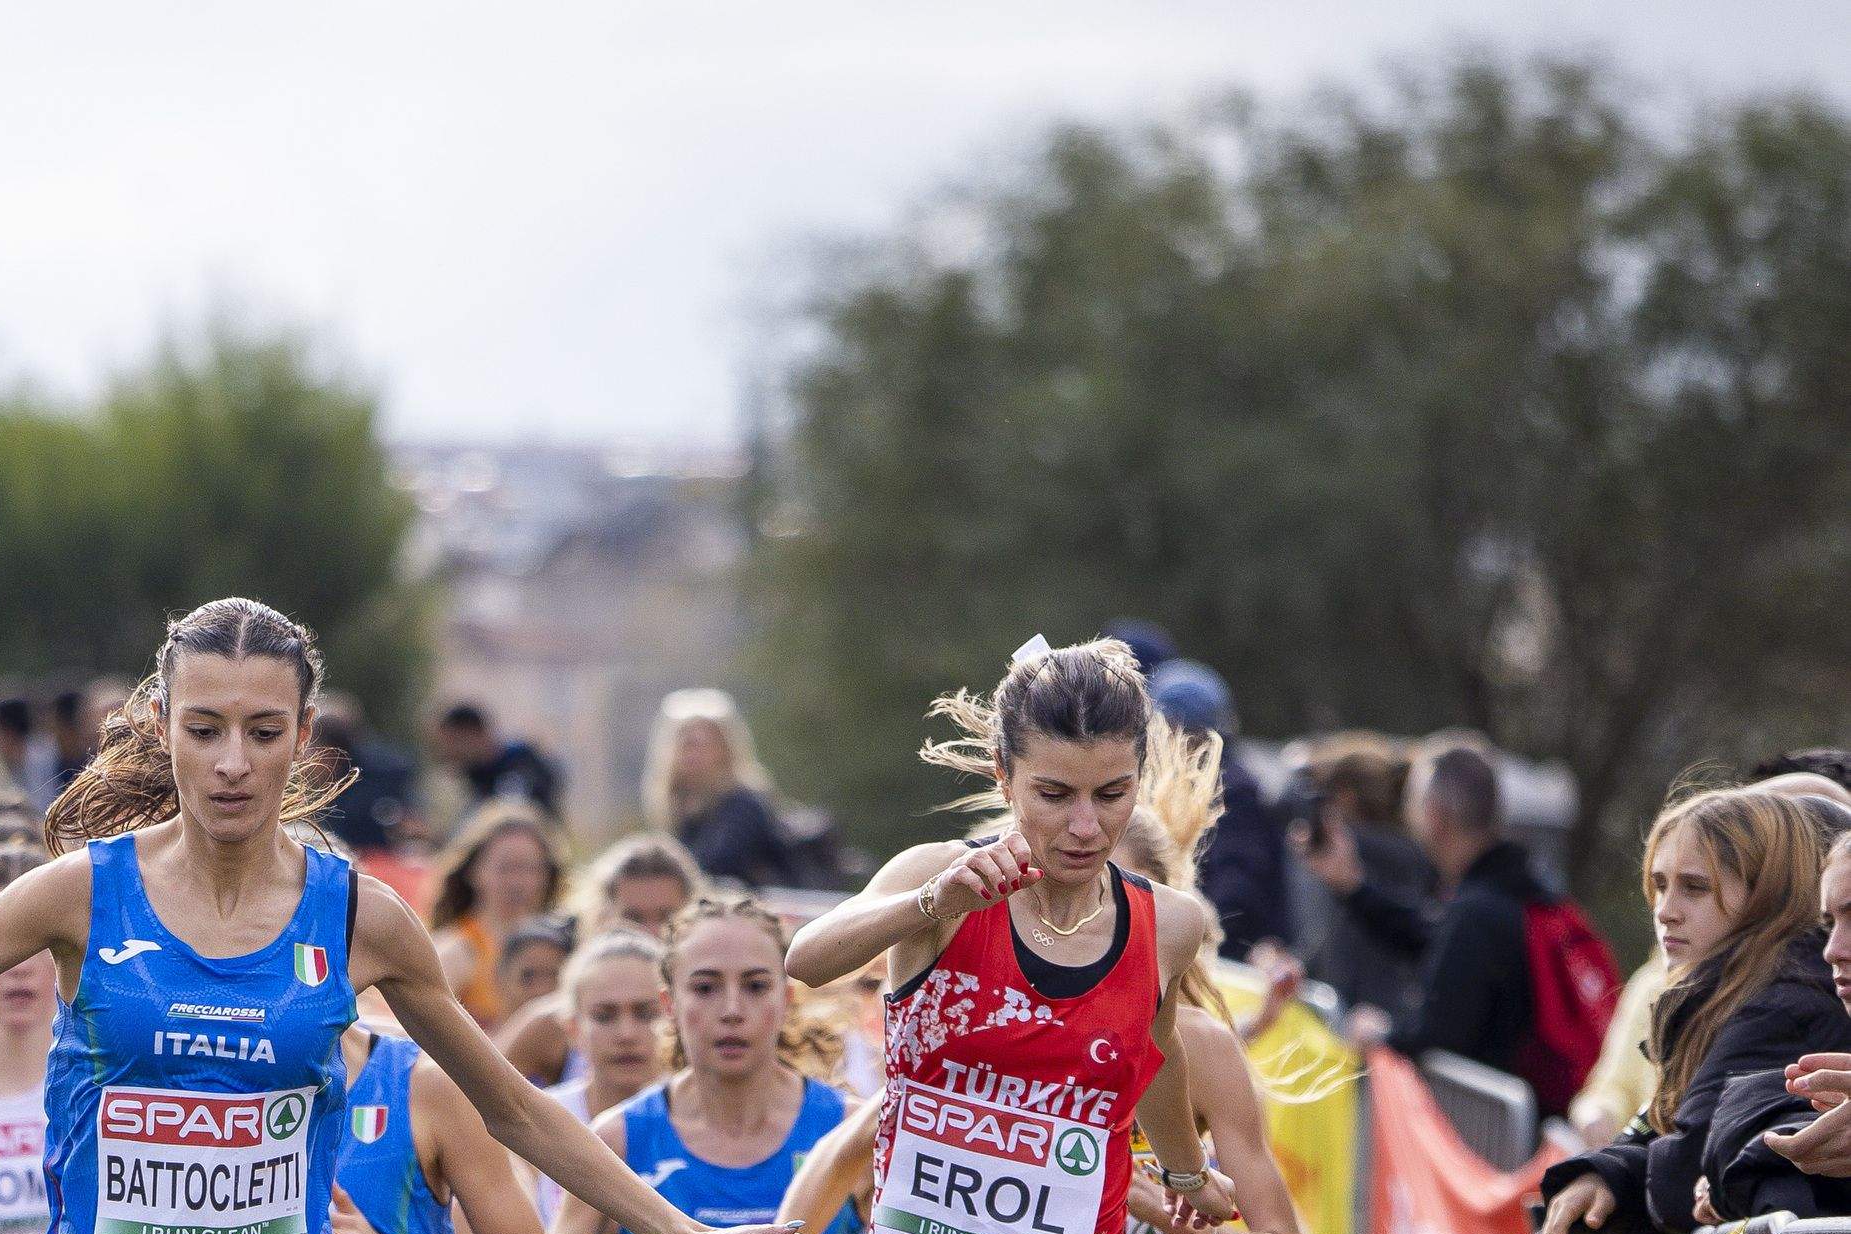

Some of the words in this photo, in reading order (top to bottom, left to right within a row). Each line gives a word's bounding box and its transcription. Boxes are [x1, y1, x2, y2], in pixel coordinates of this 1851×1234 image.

[169, 1003, 266, 1019] FRECCIAROSSA
[153, 1031, 276, 1065] ITALIA
[942, 1058, 1119, 1126] TÜRKİYE
[106, 1099, 261, 1141] SPAR
[905, 1095, 1050, 1160] SPAR
[106, 1152, 301, 1212] BATTOCLETTI
[919, 1220, 925, 1234] I
